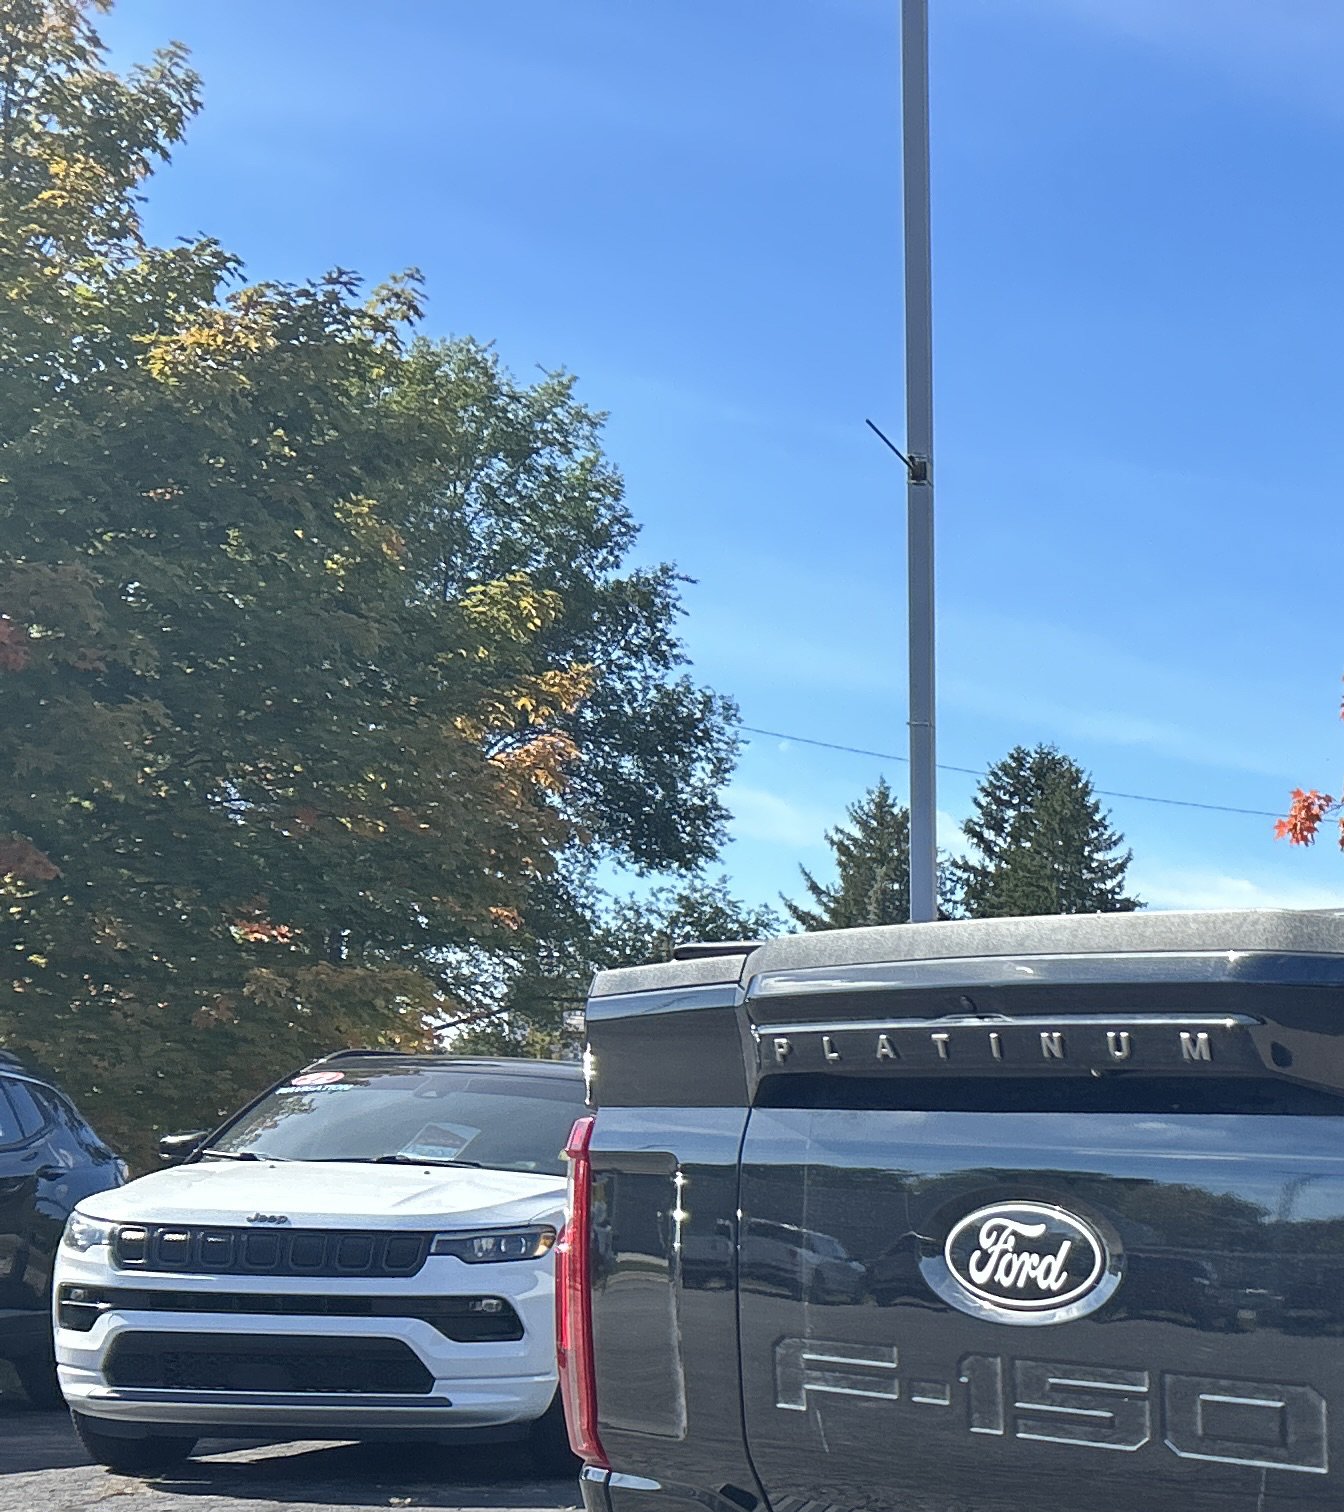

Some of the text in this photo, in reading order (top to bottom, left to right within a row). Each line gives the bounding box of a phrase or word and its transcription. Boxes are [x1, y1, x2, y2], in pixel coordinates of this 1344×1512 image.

[773, 1031, 1212, 1062] PLATINUM
[246, 1212, 289, 1225] Jeep
[968, 1217, 1072, 1291] Ford
[773, 1337, 1328, 1473] F-150
